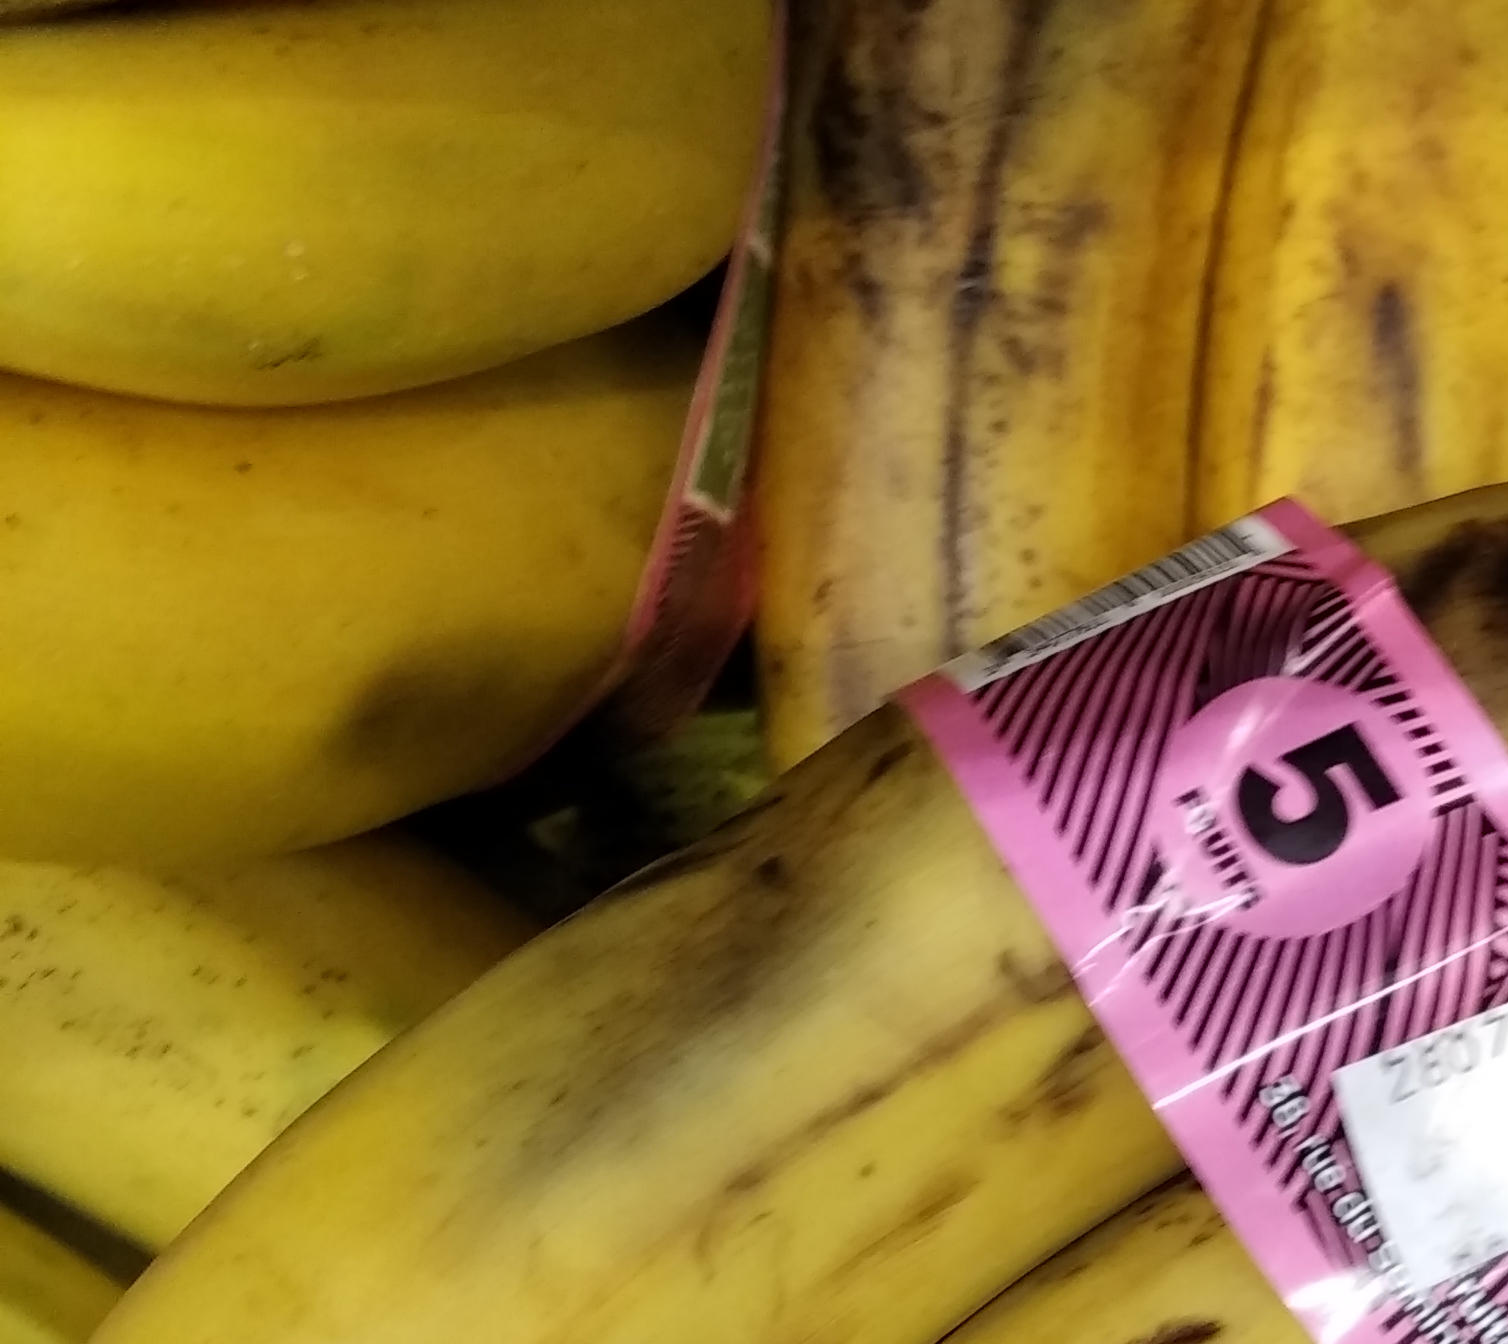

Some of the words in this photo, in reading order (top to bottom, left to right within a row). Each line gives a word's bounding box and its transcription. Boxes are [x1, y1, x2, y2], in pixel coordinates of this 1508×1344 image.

[1238, 722, 1404, 867] 5
[1294, 1133, 1347, 1194] rue
[1331, 1191, 1382, 1244] du
